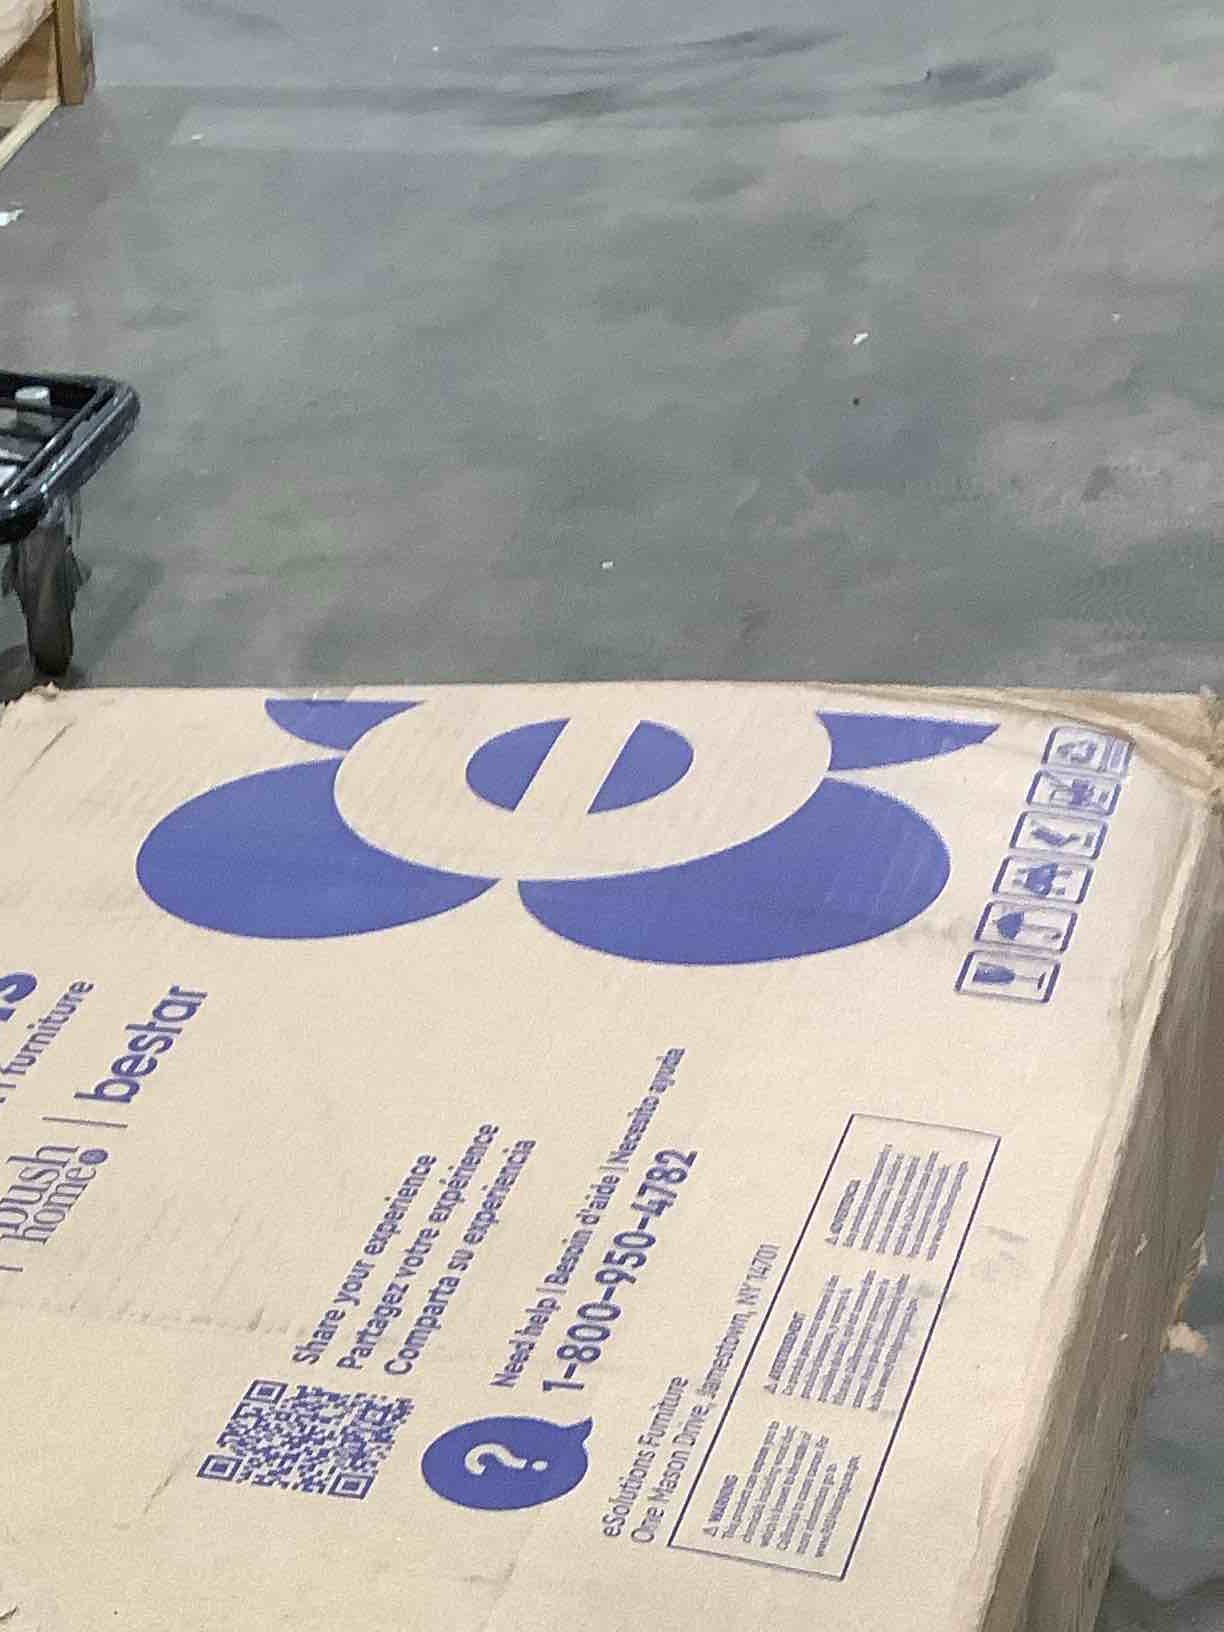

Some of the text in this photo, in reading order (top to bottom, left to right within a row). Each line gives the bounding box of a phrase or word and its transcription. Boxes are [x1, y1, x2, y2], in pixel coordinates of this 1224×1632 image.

[73, 984, 208, 1105] bestar
[292, 1154, 437, 1366] Share your experience
[336, 1123, 499, 1371] Partagez votre expérience
[383, 1139, 537, 1377] Comparta su experiencia
[488, 1338, 536, 1388] Need
[514, 1297, 562, 1337] help
[543, 1229, 593, 1287] Besoin
[576, 1174, 621, 1227] d'aide
[542, 1148, 698, 1392] 1-800-950-4782
[735, 1280, 765, 1310] NY
[746, 1243, 780, 1282] 14701
[696, 1309, 758, 1401] Jamestown,
[602, 1375, 689, 1539] eSolutions Furniture
[630, 1505, 666, 1544] One
[647, 1448, 691, 1506] Mason
